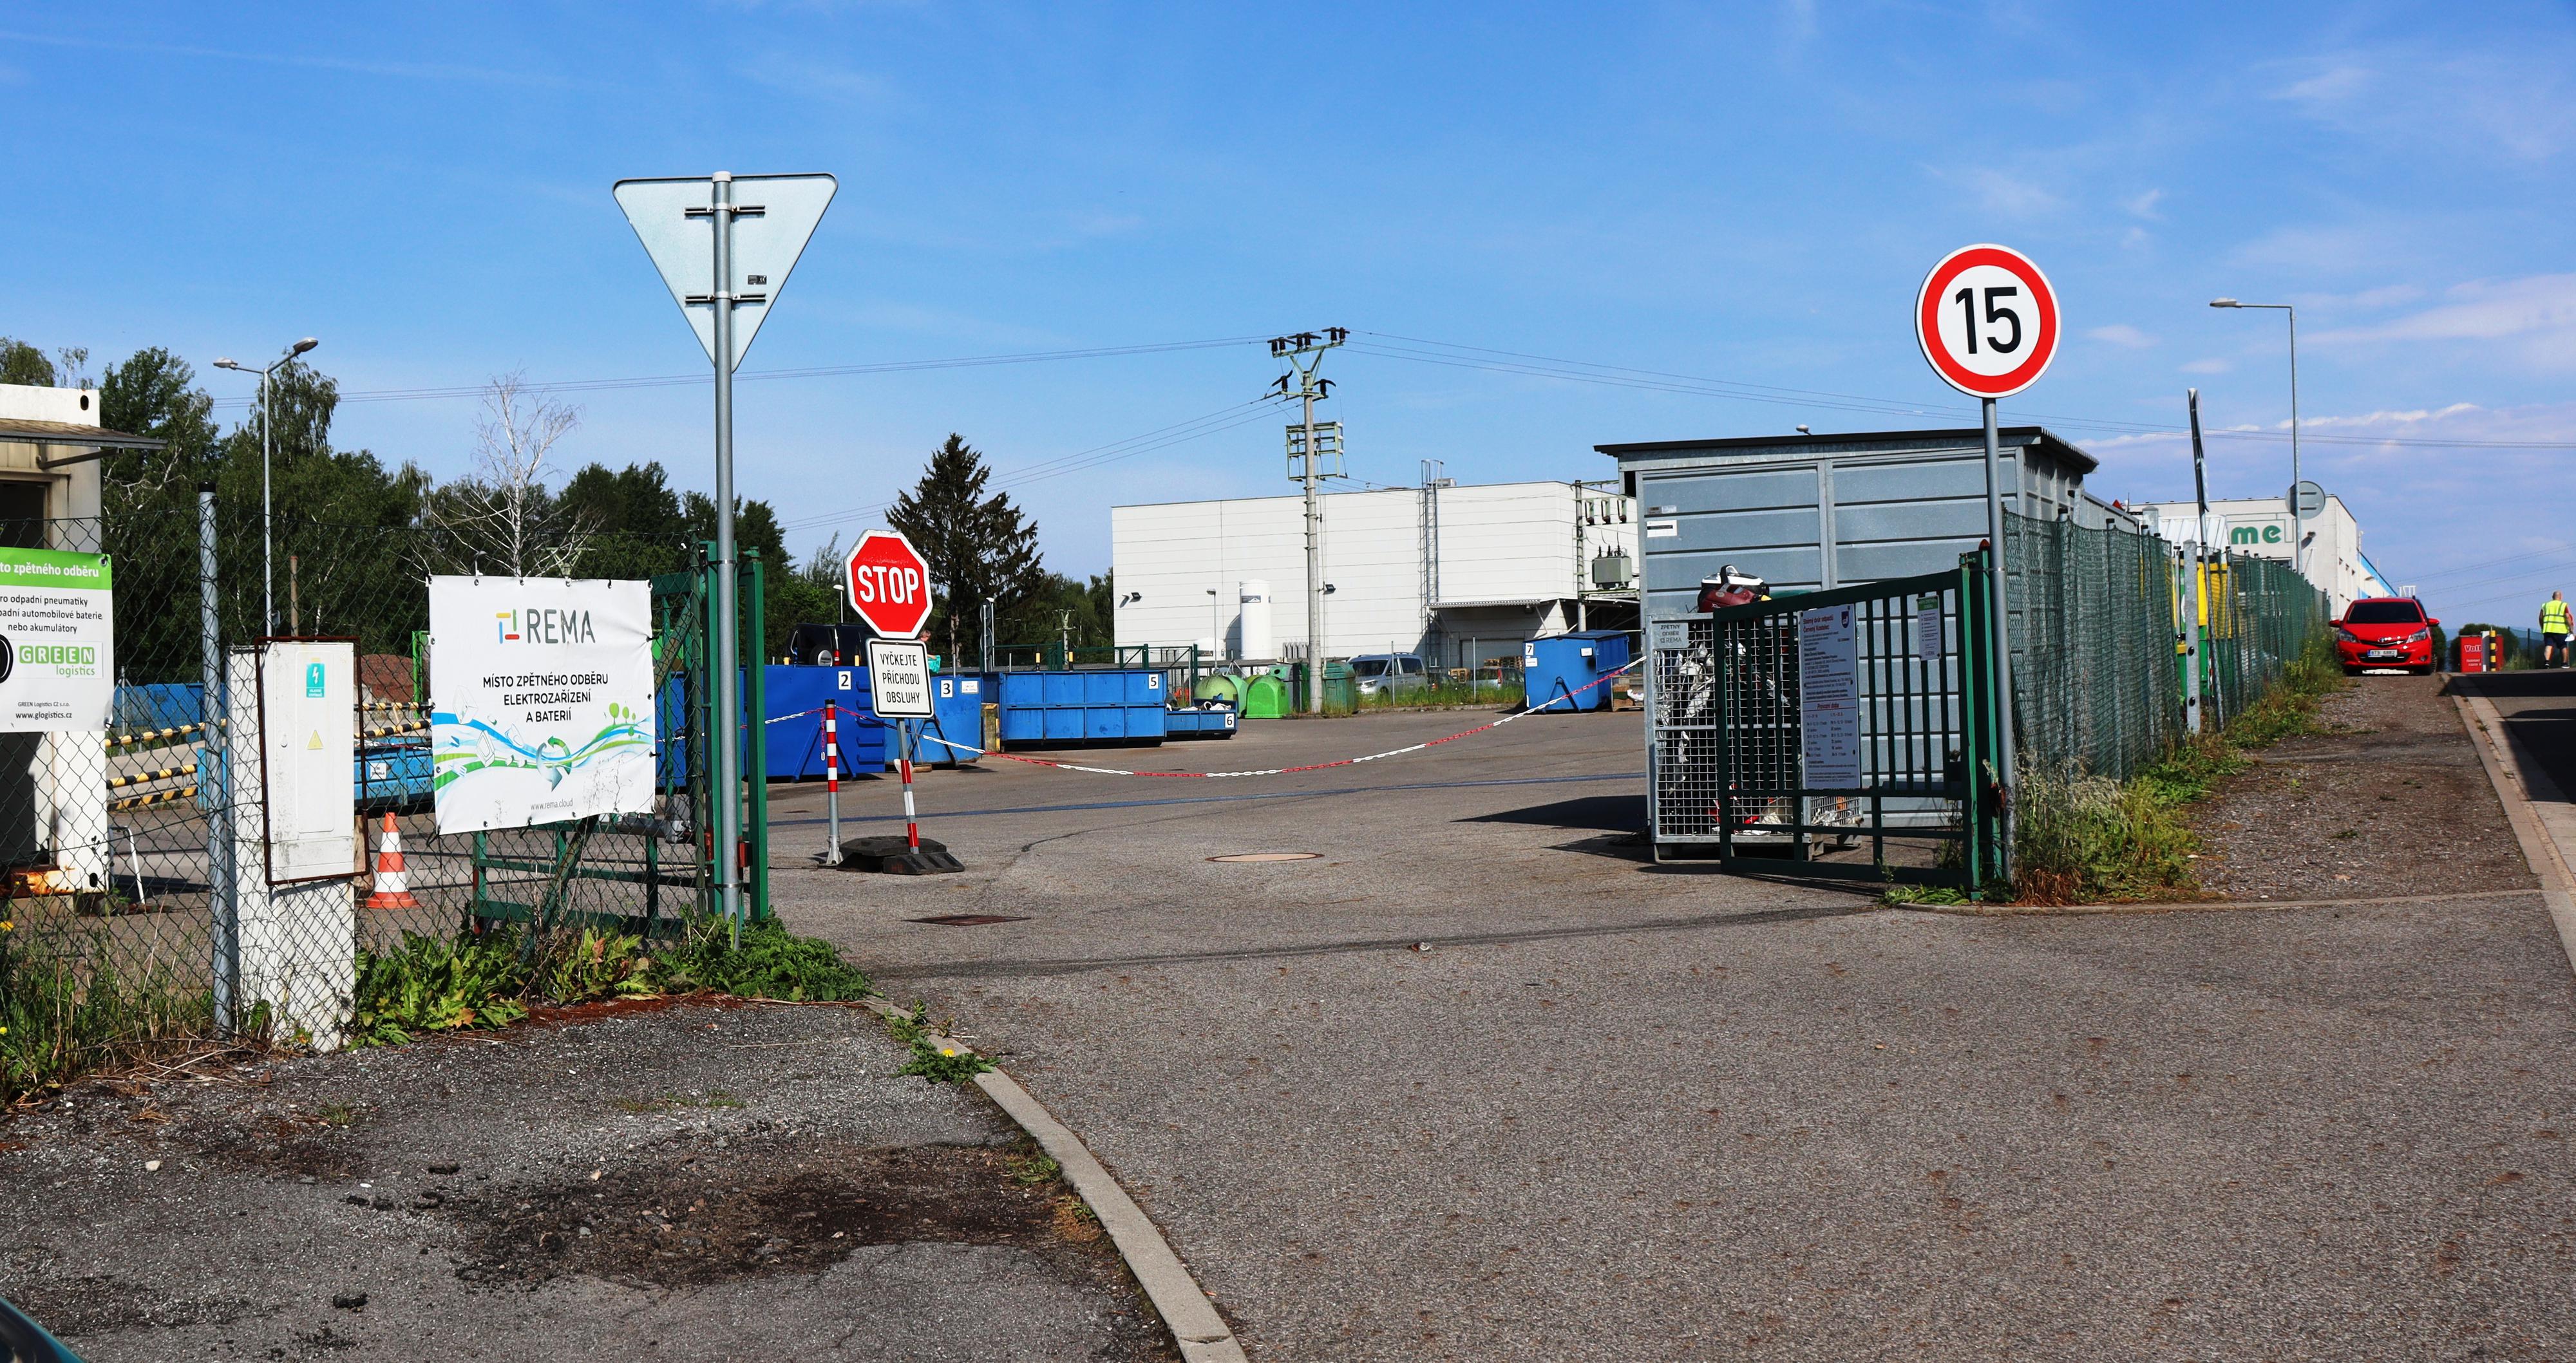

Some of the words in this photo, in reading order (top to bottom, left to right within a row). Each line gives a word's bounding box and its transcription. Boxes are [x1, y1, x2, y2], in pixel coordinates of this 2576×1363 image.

[1956, 287, 2021, 354] 15
[14, 562, 61, 576] zpětného
[63, 565, 99, 578] odběru
[858, 565, 919, 605] STOP
[10, 594, 42, 605] odpadní
[44, 597, 88, 607] pneumatiky
[22, 610, 74, 619] automobilové
[76, 611, 103, 620] baterie
[8, 623, 28, 631] nebo
[30, 623, 77, 634] akumulátory
[527, 608, 596, 644] REMA
[21, 646, 94, 663] GREEN
[1527, 645, 1532, 653] 7
[880, 651, 918, 666] VYČKEJTE
[56, 665, 95, 678] logistics
[882, 670, 920, 685] PŘÍCHODU
[483, 673, 514, 688] MÍSTO
[516, 672, 568, 687] ZPĚTNÉHO
[571, 671, 609, 685] ODBĚRU
[840, 674, 849, 687] 2
[1150, 677, 1157, 687] 5
[942, 683, 951, 695] 3
[504, 689, 591, 706] ELEKTROZAŘÍZENÍ
[886, 691, 920, 704] OBSLUHY
[15, 711, 72, 720] www.glogistics.cz
[526, 711, 533, 722] A
[536, 707, 571, 722] BATERIÍ
[1226, 715, 1233, 726] 6
[530, 798, 573, 811] www.rema.cloud
